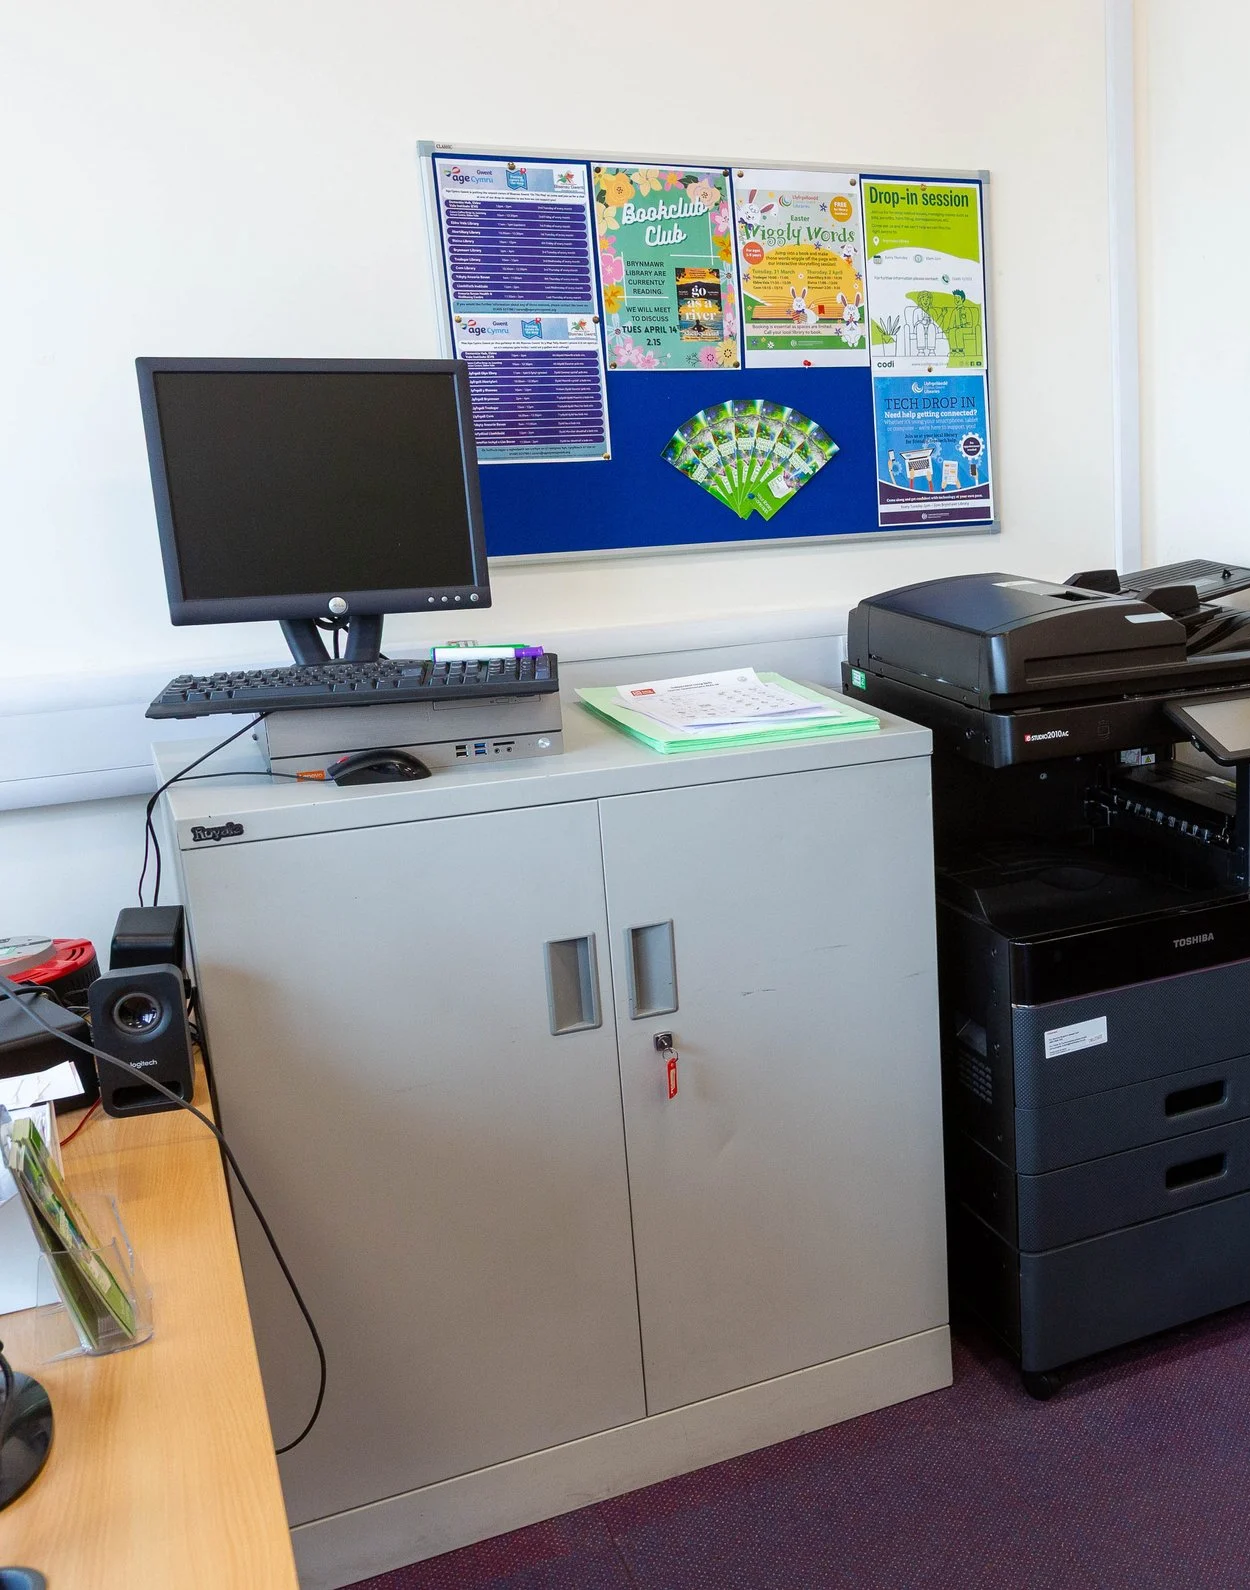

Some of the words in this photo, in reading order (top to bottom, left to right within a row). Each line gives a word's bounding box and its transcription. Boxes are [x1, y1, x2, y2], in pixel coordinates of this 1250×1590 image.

[452, 174, 470, 184] age
[870, 186, 918, 208] Drop-in
[922, 190, 968, 207] session
[622, 198, 709, 225] Bookclub
[645, 223, 687, 247] Club
[744, 223, 802, 247] Wiggly
[806, 226, 855, 242] Words
[691, 285, 706, 298] go
[685, 310, 716, 320] river
[469, 327, 486, 336] age
[884, 398, 918, 410] TECH
[922, 397, 957, 409] DROP
[962, 397, 975, 408] IN
[1173, 932, 1214, 948] TOSHIBA
[130, 1059, 158, 1069] logitech
